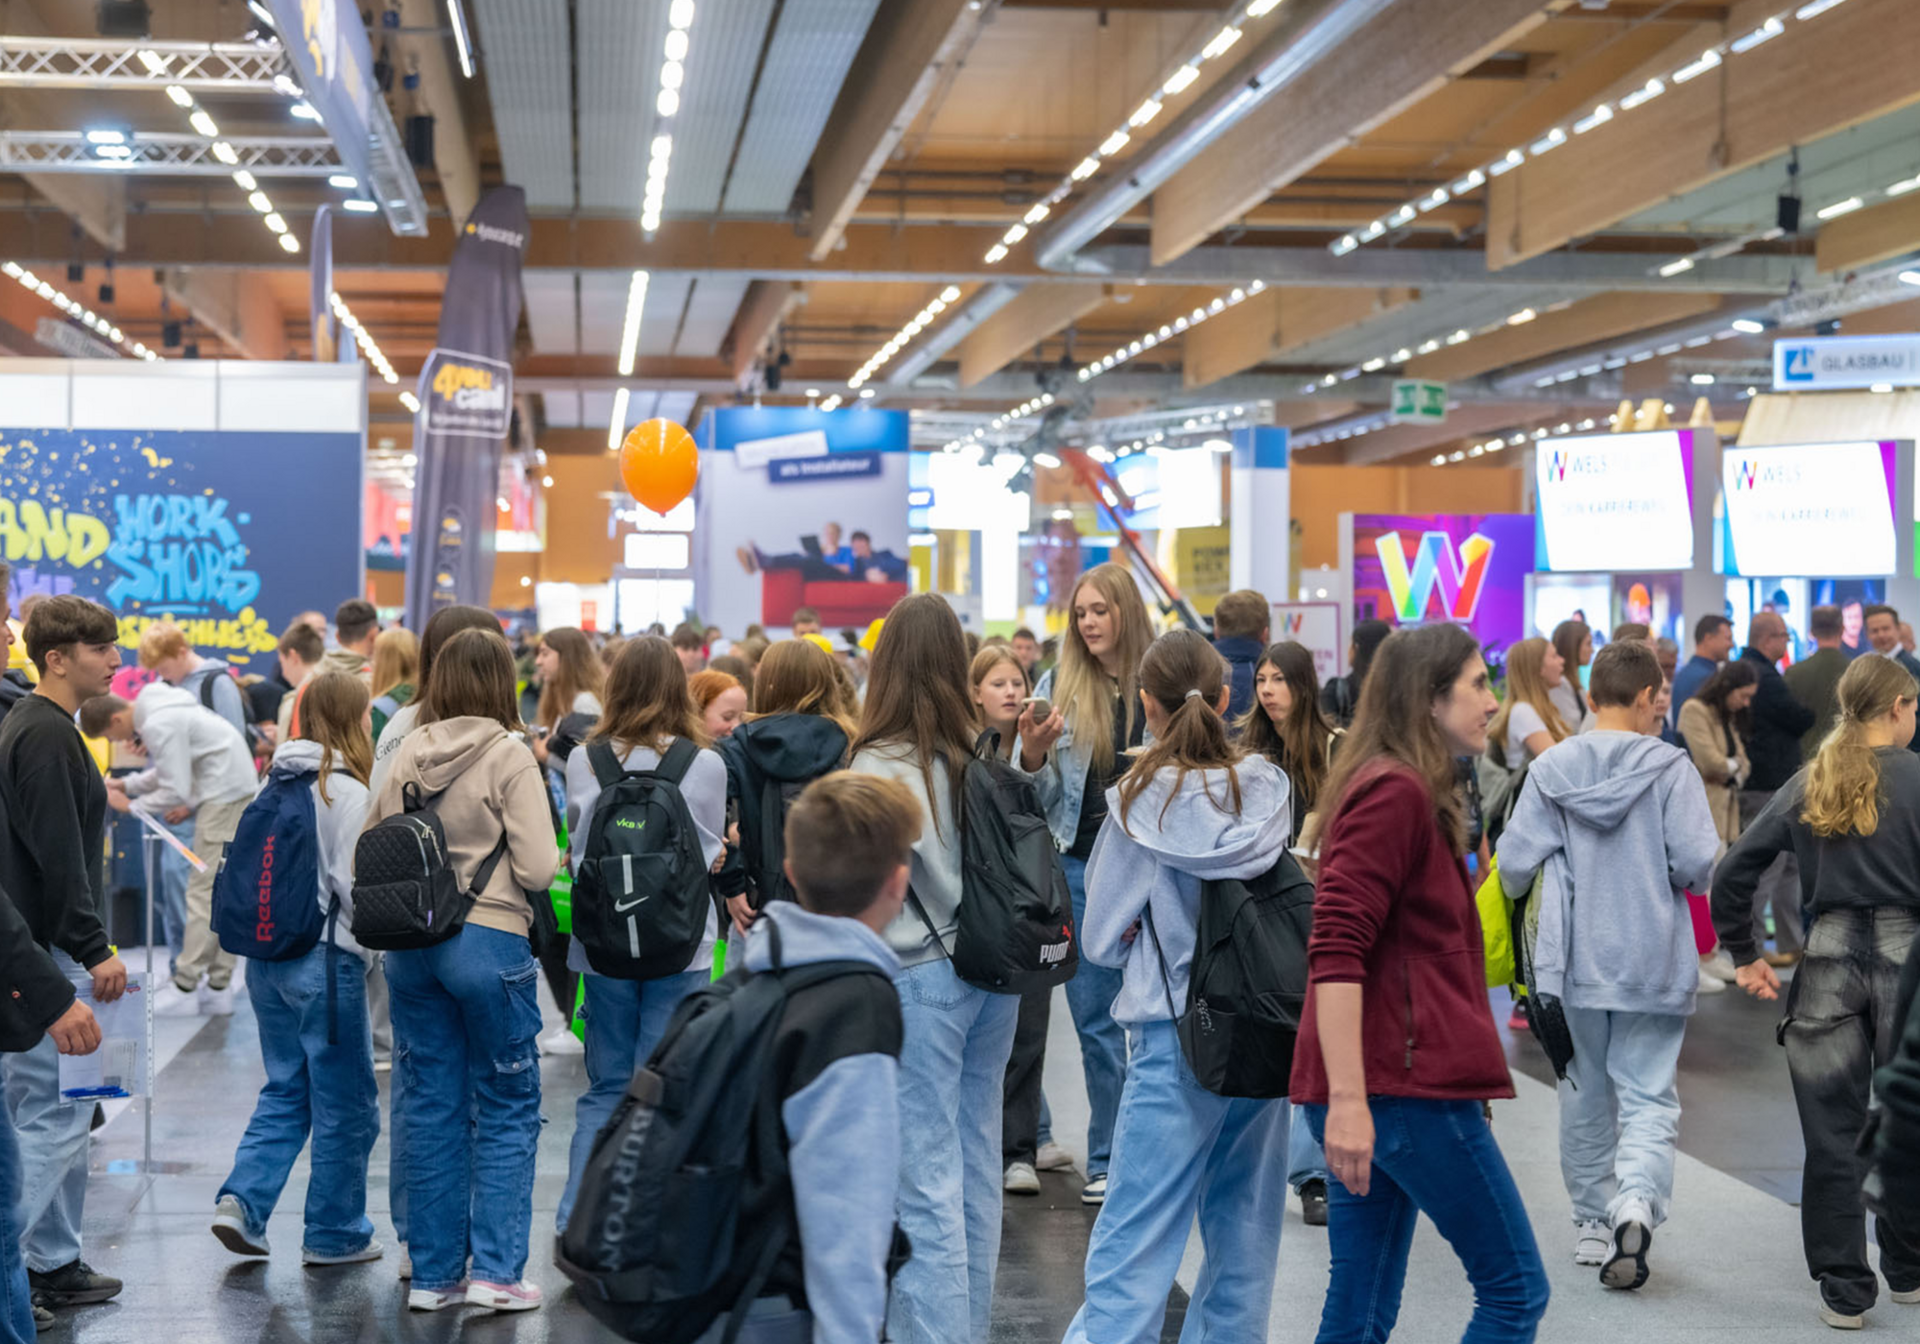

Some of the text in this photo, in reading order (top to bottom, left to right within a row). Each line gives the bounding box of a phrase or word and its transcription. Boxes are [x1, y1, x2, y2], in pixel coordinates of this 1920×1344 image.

[1820, 351, 1906, 372] GLASBAU
[256, 835, 276, 942] Reebok
[599, 1108, 654, 1272] BURTON
